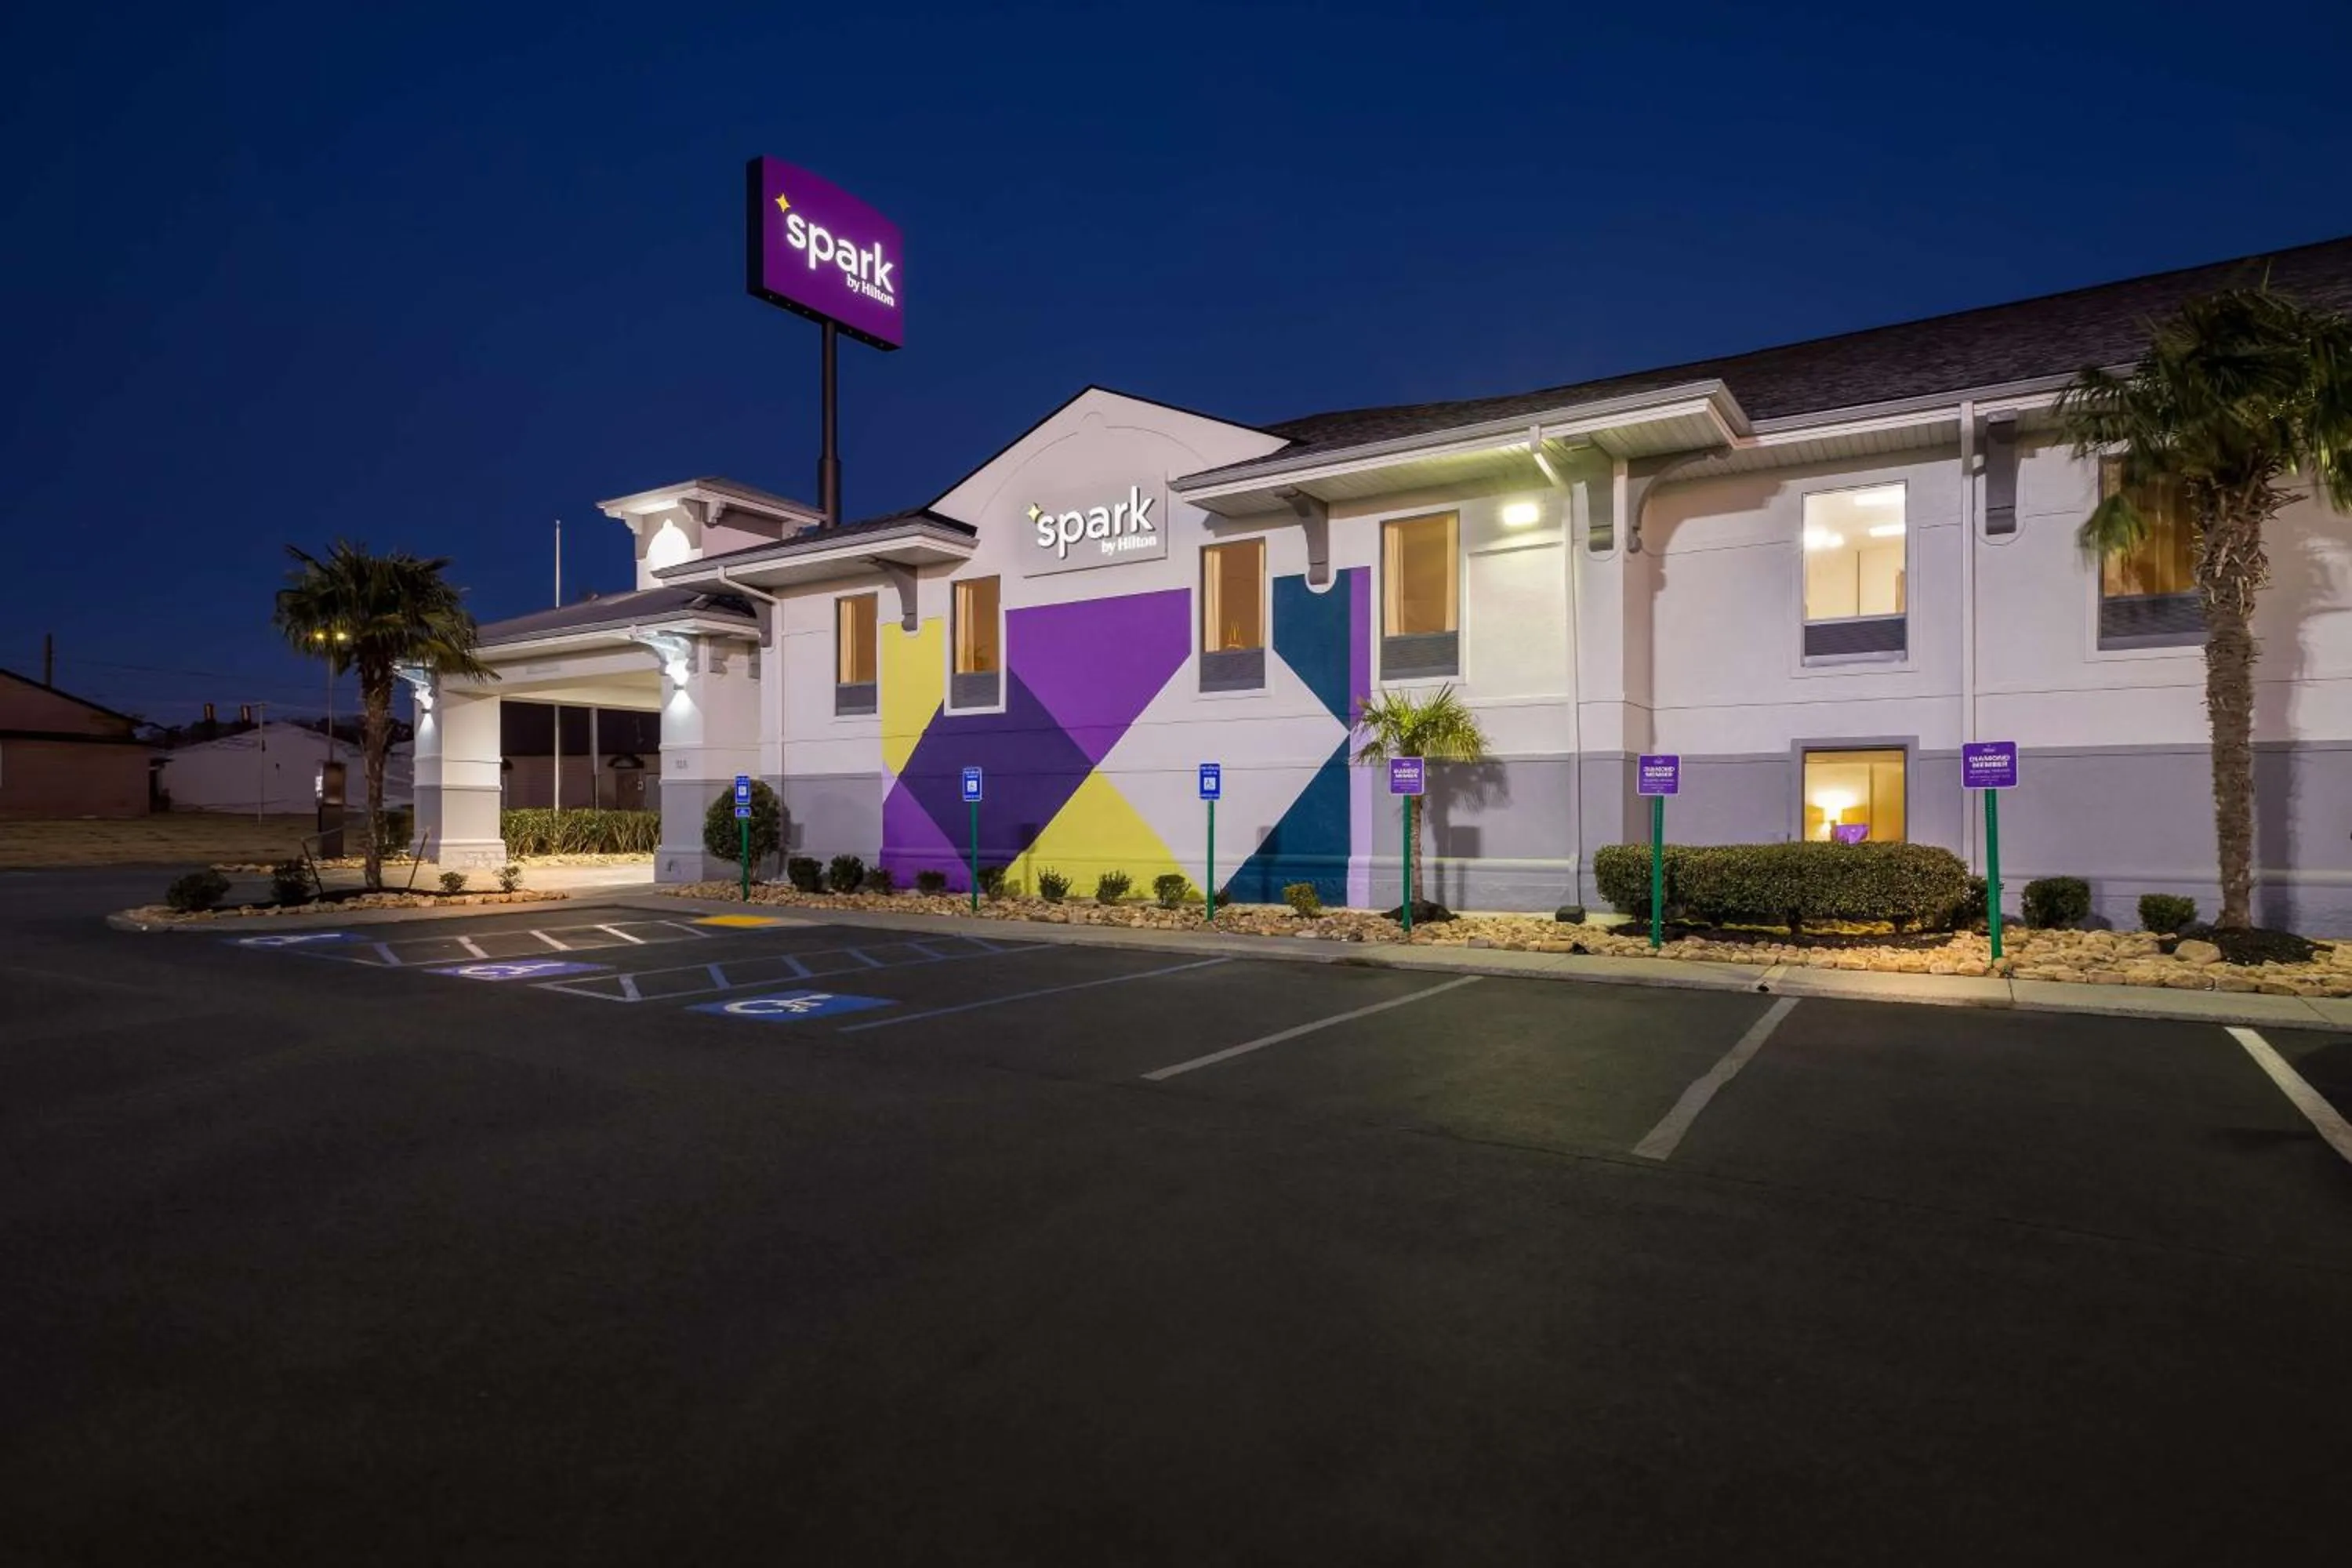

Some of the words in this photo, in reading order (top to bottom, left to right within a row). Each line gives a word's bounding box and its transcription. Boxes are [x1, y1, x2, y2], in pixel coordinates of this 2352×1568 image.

[786, 213, 895, 294] spark
[847, 274, 860, 292] by
[862, 280, 895, 307] Hilton
[1037, 485, 1156, 560] spark
[1101, 540, 1116, 556] by
[1117, 535, 1157, 551] Hilton
